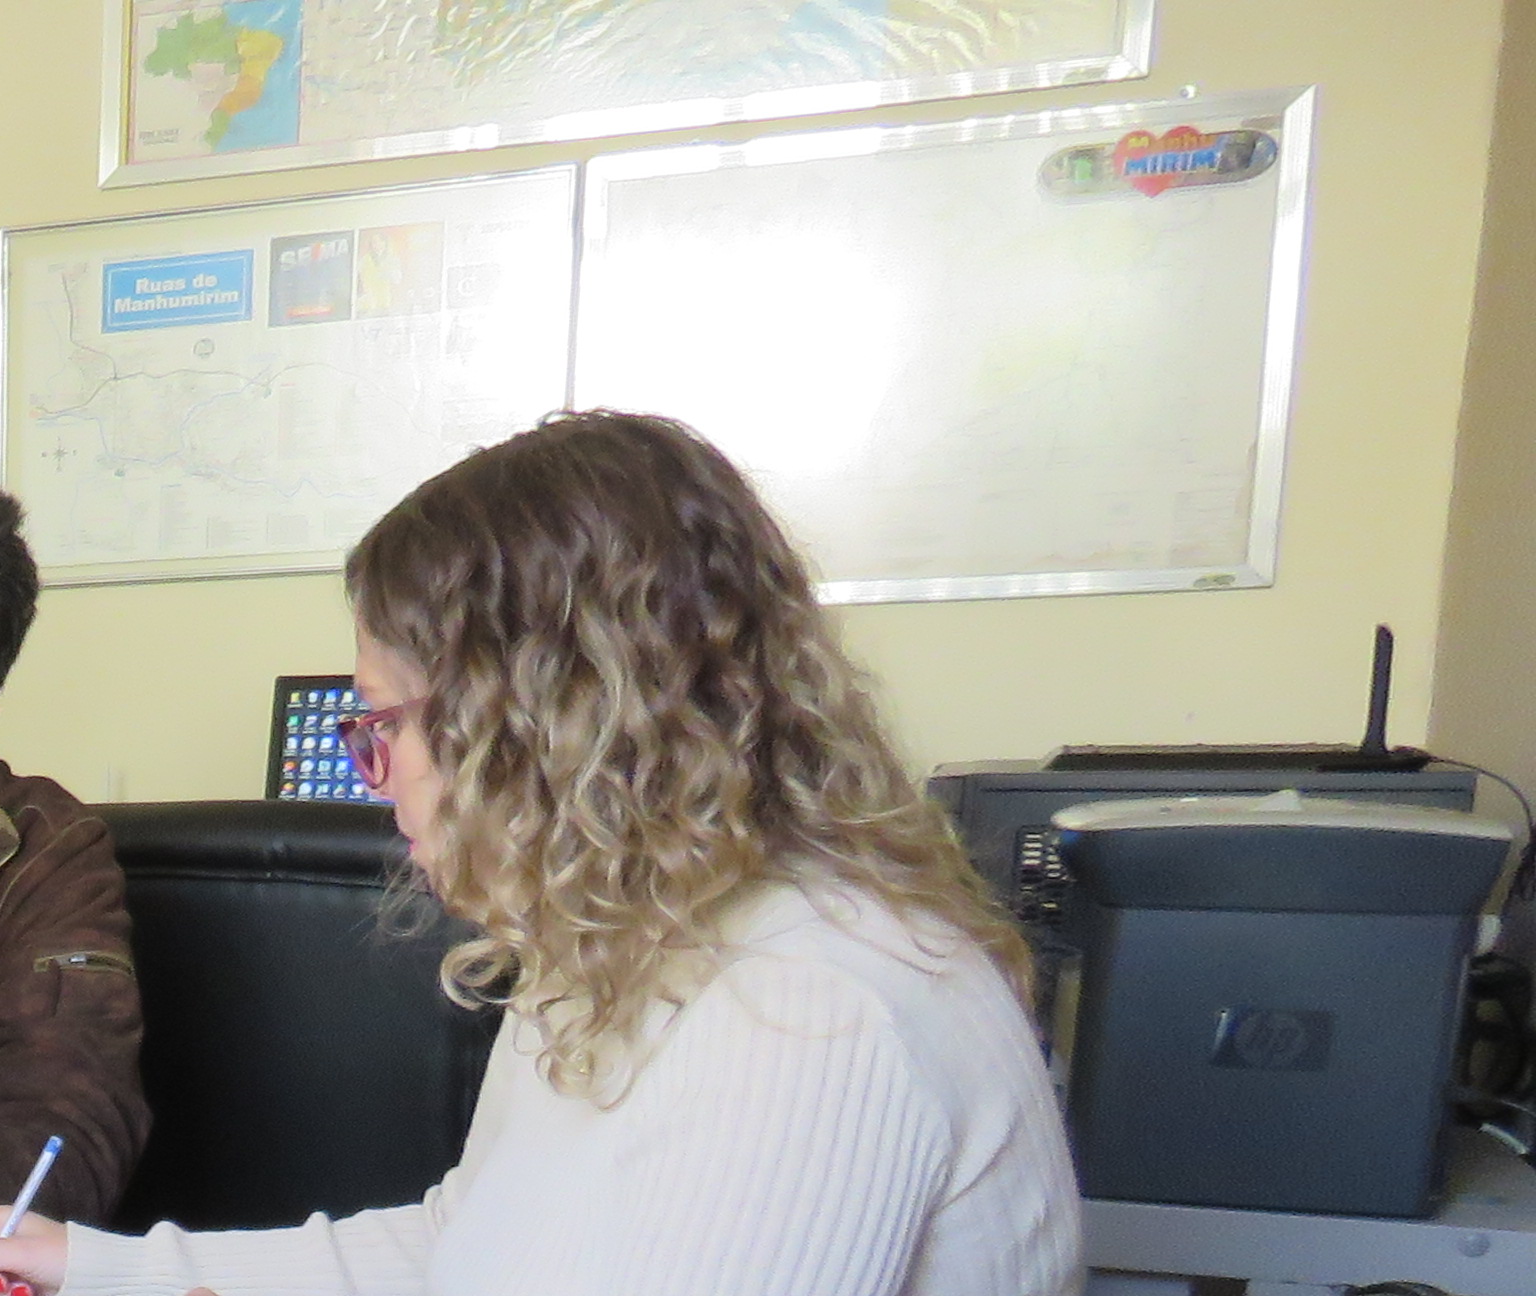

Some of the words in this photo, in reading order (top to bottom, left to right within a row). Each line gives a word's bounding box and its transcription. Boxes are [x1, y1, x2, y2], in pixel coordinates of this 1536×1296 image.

[135, 277, 186, 294] Ruas
[192, 273, 218, 289] de
[114, 290, 239, 313] Manhumirim
